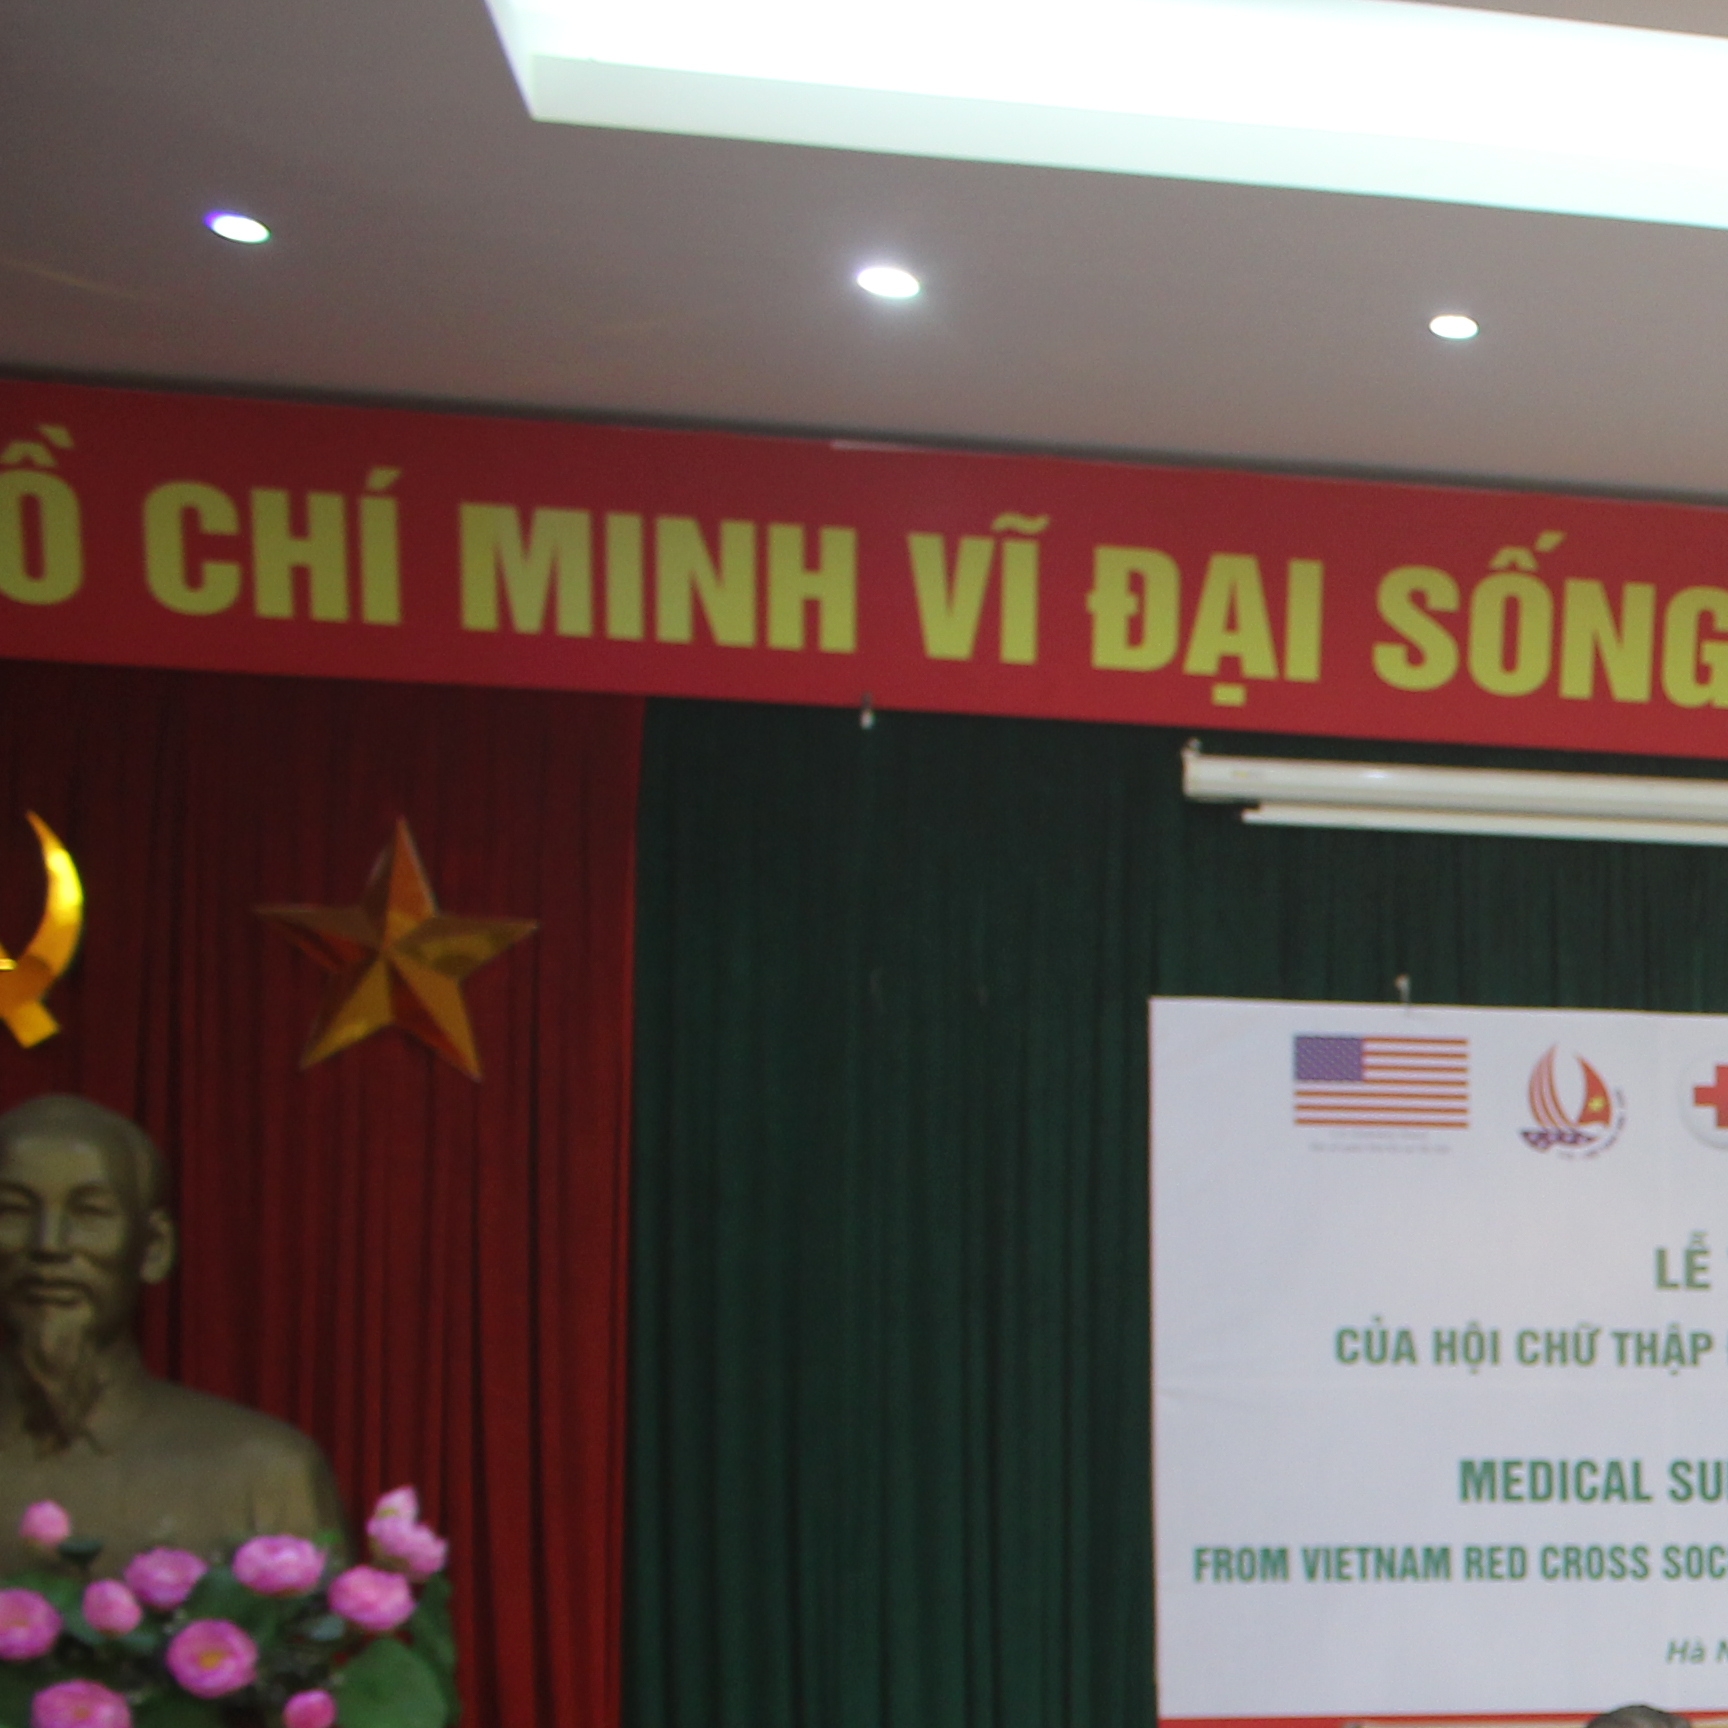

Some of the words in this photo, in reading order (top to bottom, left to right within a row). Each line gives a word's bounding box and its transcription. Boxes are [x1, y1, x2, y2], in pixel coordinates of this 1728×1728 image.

[142, 468, 402, 626] CHÍ
[459, 501, 858, 654] MINH
[907, 512, 1050, 665] VĨ
[1086, 545, 1325, 706] ĐẠI
[1653, 1230, 1711, 1291] LỄ
[1334, 1316, 1418, 1365] CỦA
[1432, 1322, 1500, 1375] HỘI
[1515, 1325, 1601, 1367] CHỮ
[1611, 1323, 1714, 1376] THẬP
[1458, 1459, 1653, 1503] MEDICAL
[1192, 1545, 1289, 1583] FROM
[1301, 1545, 1451, 1583] VIETNAM
[1463, 1545, 1528, 1581] RED
[1540, 1544, 1650, 1581] CROSS
[1666, 1638, 1707, 1666] Hà
